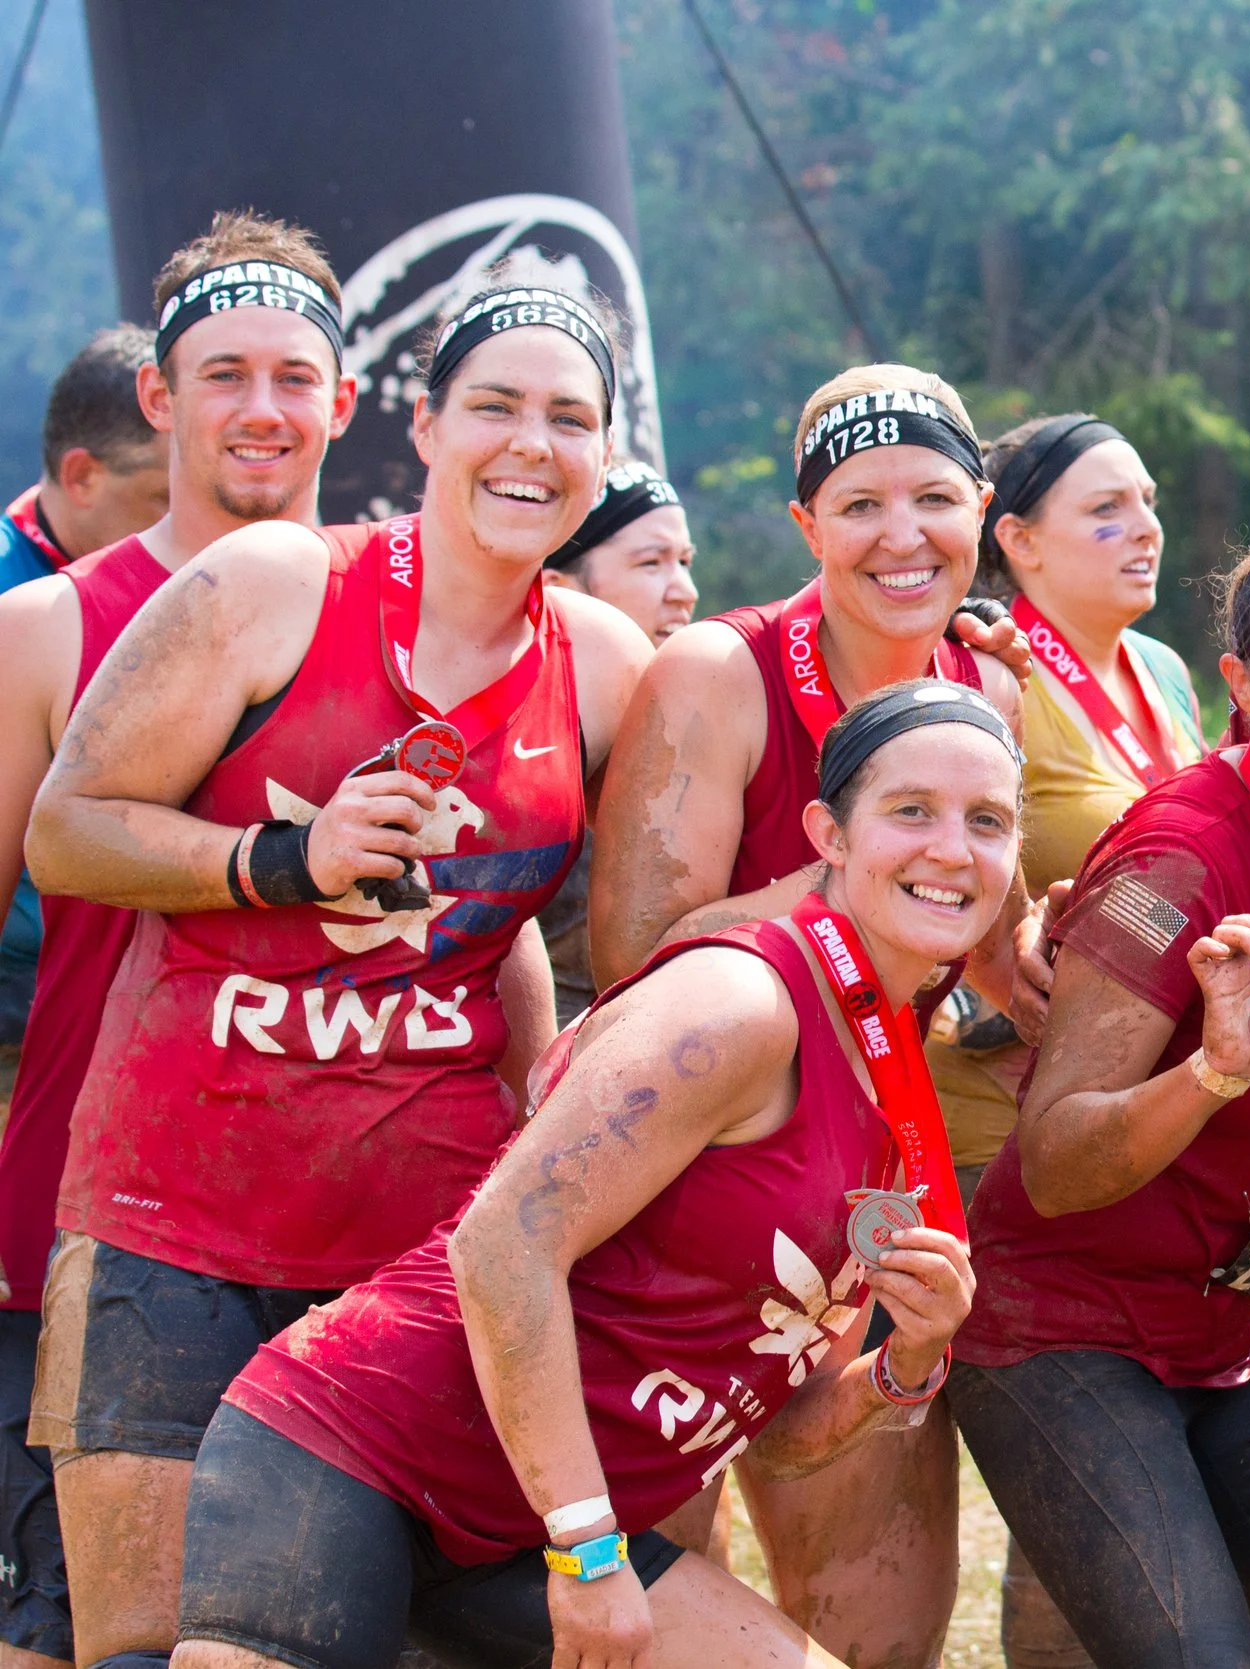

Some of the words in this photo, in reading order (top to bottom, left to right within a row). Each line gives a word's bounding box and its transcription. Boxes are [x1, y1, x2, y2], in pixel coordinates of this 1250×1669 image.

[210, 285, 306, 314] 6267
[491, 305, 588, 344] 5620
[804, 389, 939, 455] SPARTAN
[826, 417, 900, 465] 1728
[789, 617, 823, 696] AROO!
[813, 917, 862, 986] SPARTAN
[861, 1015, 891, 1059] RACE
[211, 974, 473, 1060] RWB
[112, 1192, 163, 1211] DRI-FIT
